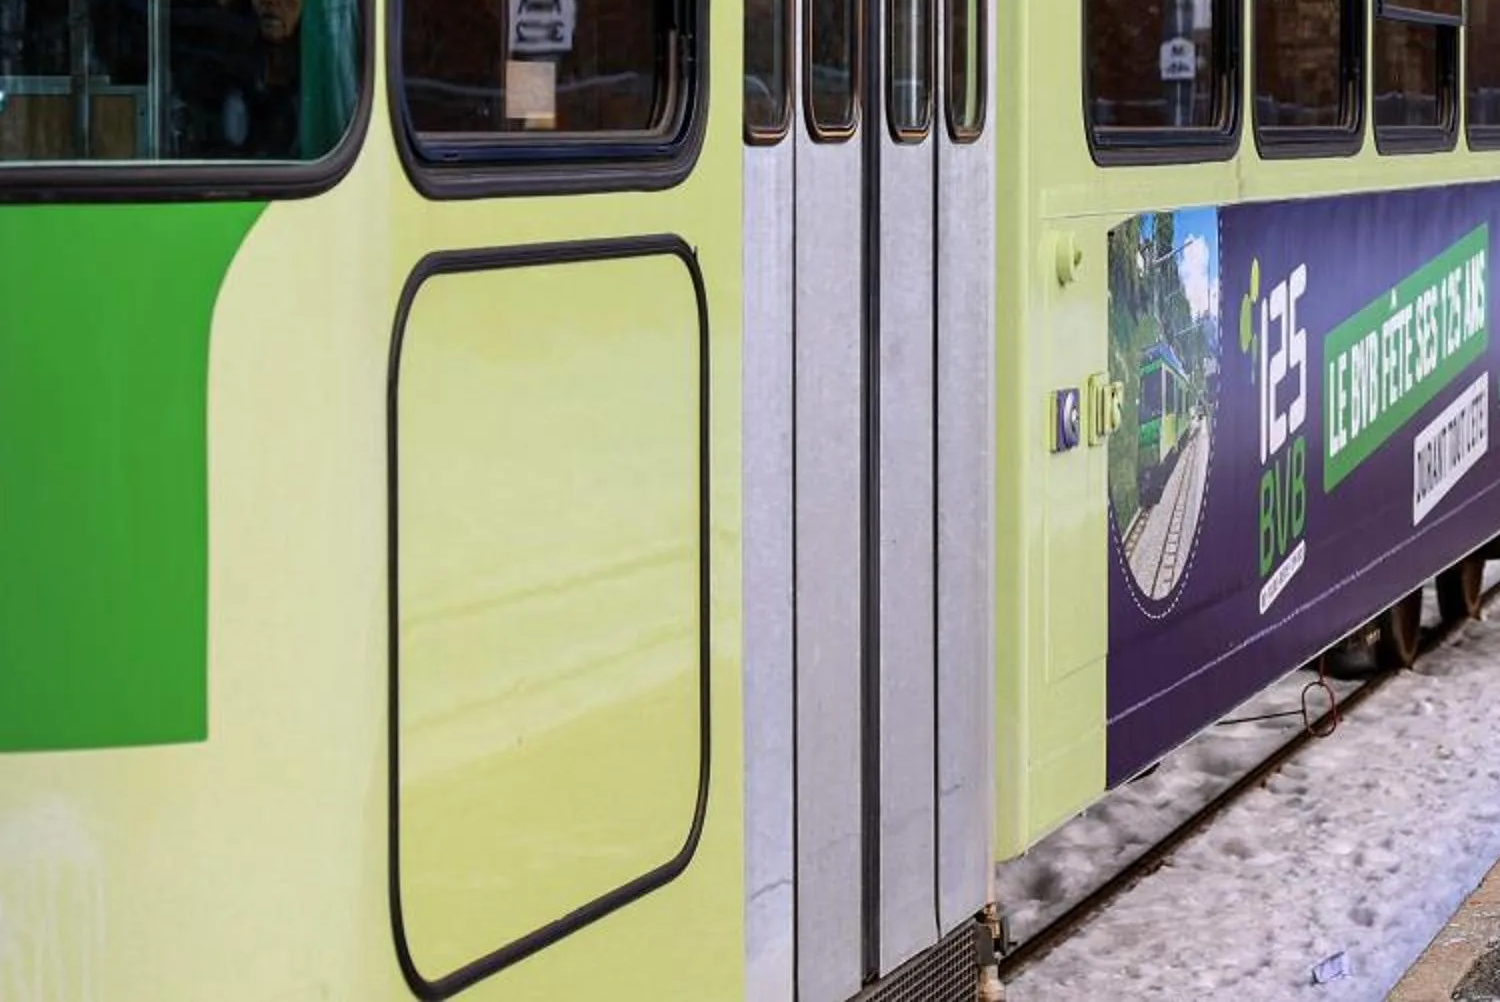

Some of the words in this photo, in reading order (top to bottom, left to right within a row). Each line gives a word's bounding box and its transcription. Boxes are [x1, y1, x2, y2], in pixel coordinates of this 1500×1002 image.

[1260, 263, 1307, 464] 125
[1329, 351, 1348, 458] LE
[1351, 330, 1379, 439] BVB
[1381, 286, 1414, 413] FÊTE
[1415, 284, 1439, 383] SES
[1441, 266, 1461, 360] 125
[1463, 248, 1485, 342] ANS
[1259, 436, 1306, 577] BVB
